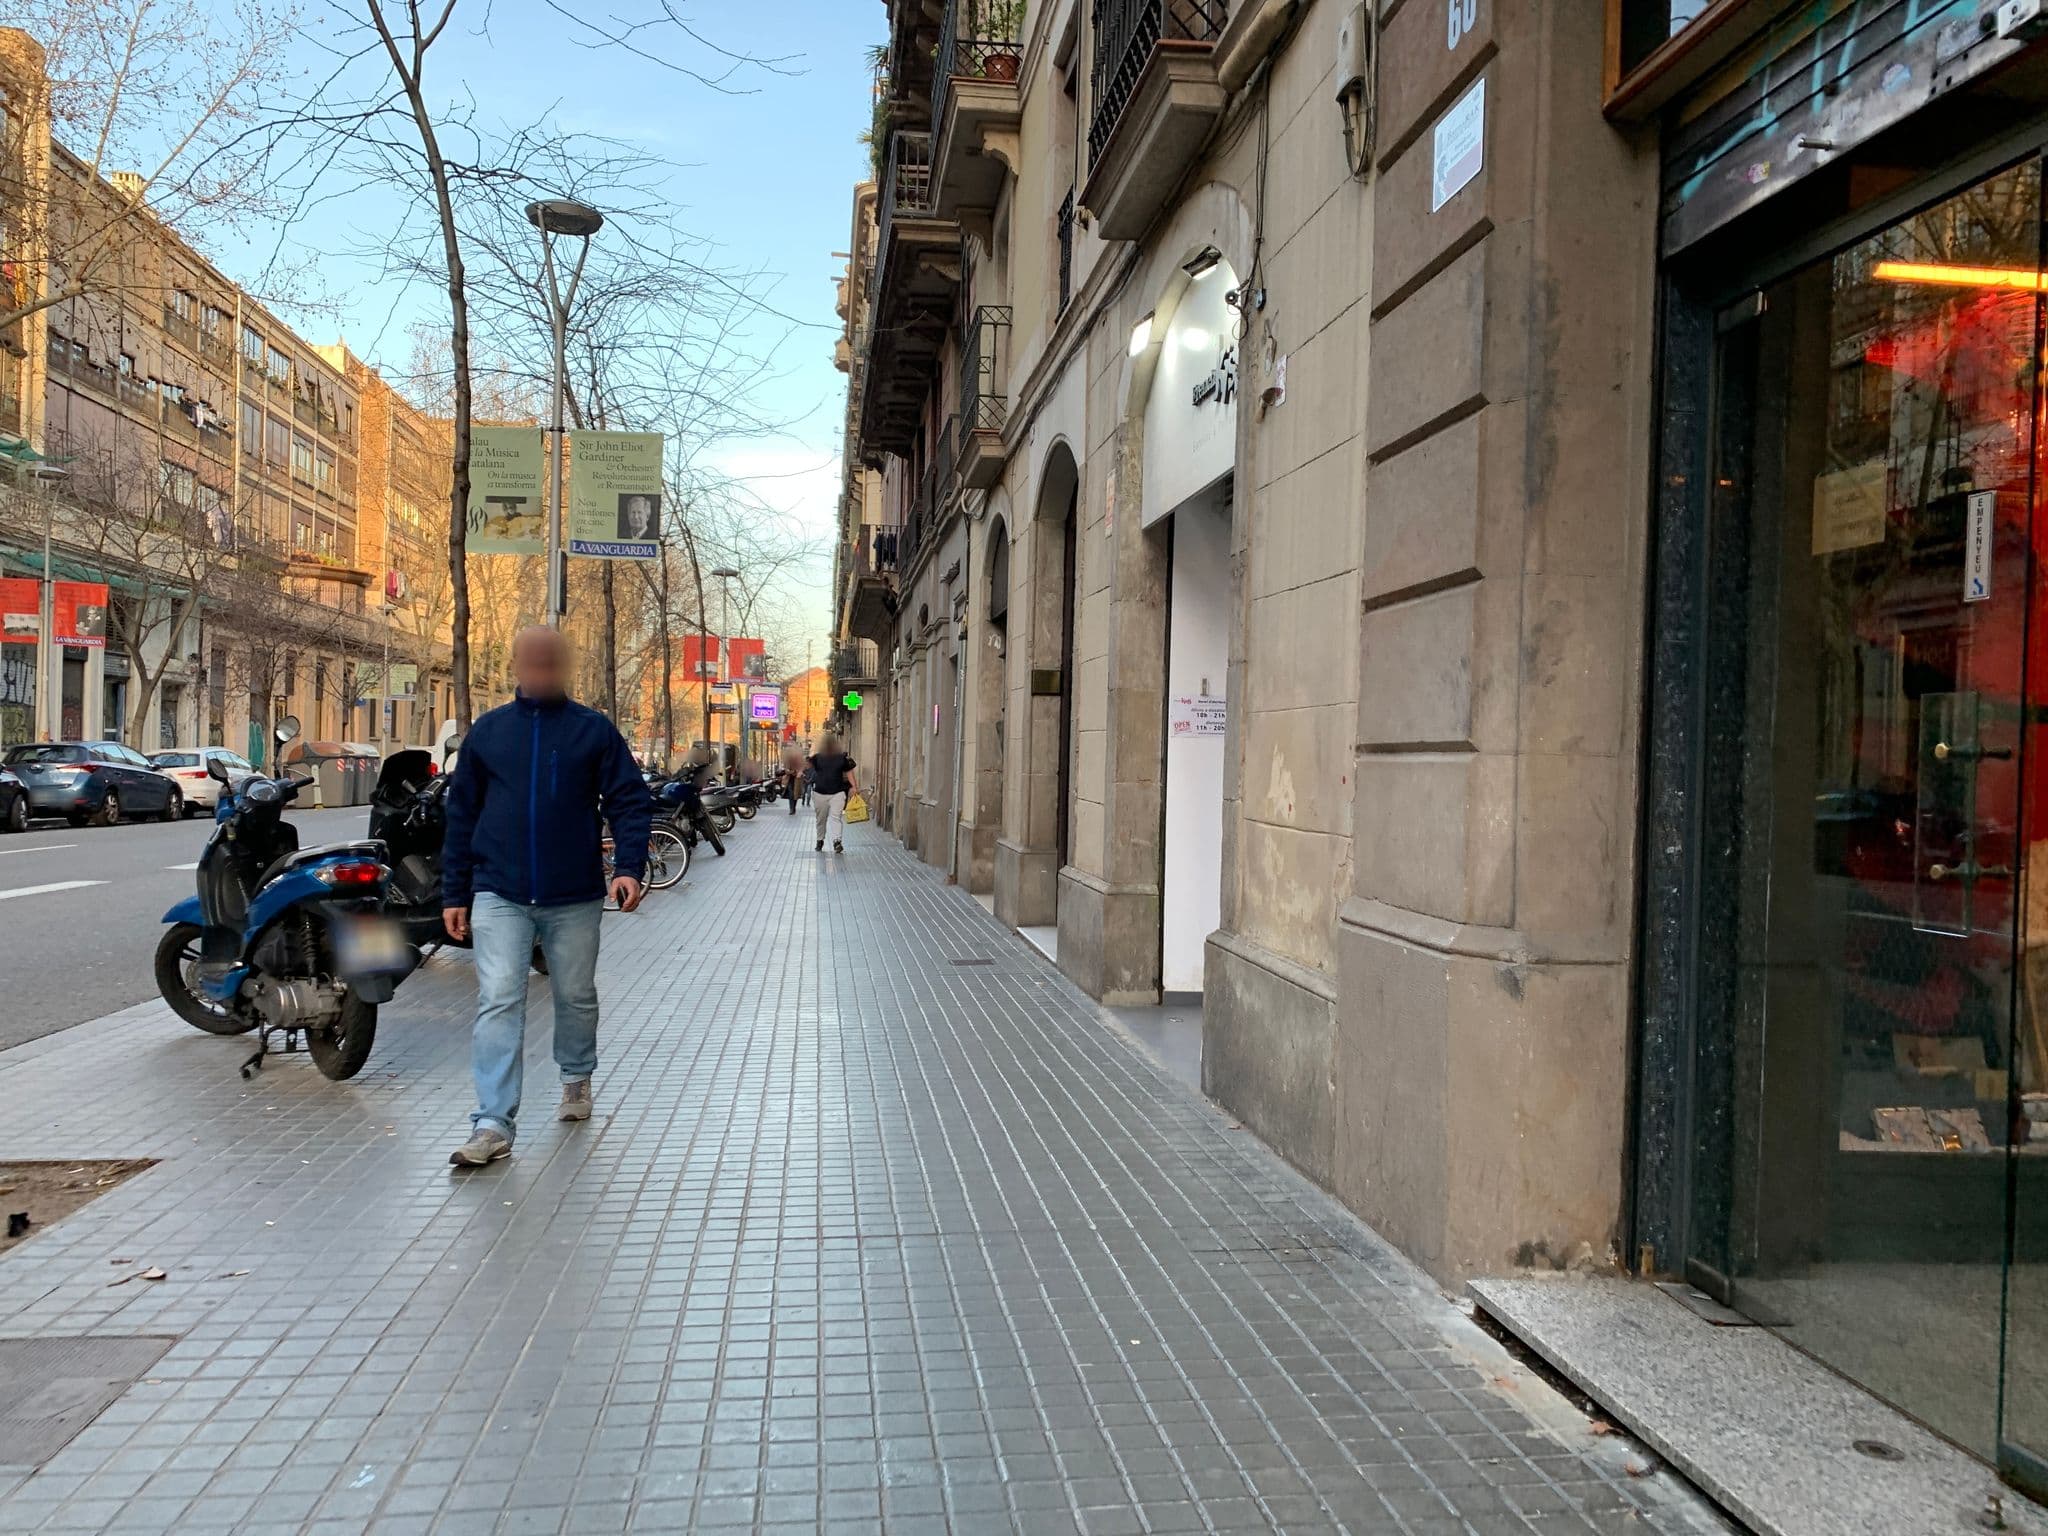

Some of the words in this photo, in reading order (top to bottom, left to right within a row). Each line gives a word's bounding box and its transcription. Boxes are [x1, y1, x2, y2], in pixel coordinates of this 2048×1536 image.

[469, 437, 489, 446] alau
[579, 440, 593, 450] Sir
[595, 440, 619, 452] John
[621, 441, 644, 452] Eliot
[579, 451, 625, 462] Gardiner
[471, 459, 505, 468] atalana
[577, 498, 597, 507] Nou
[1974, 497, 1984, 574] EMPENYEU
